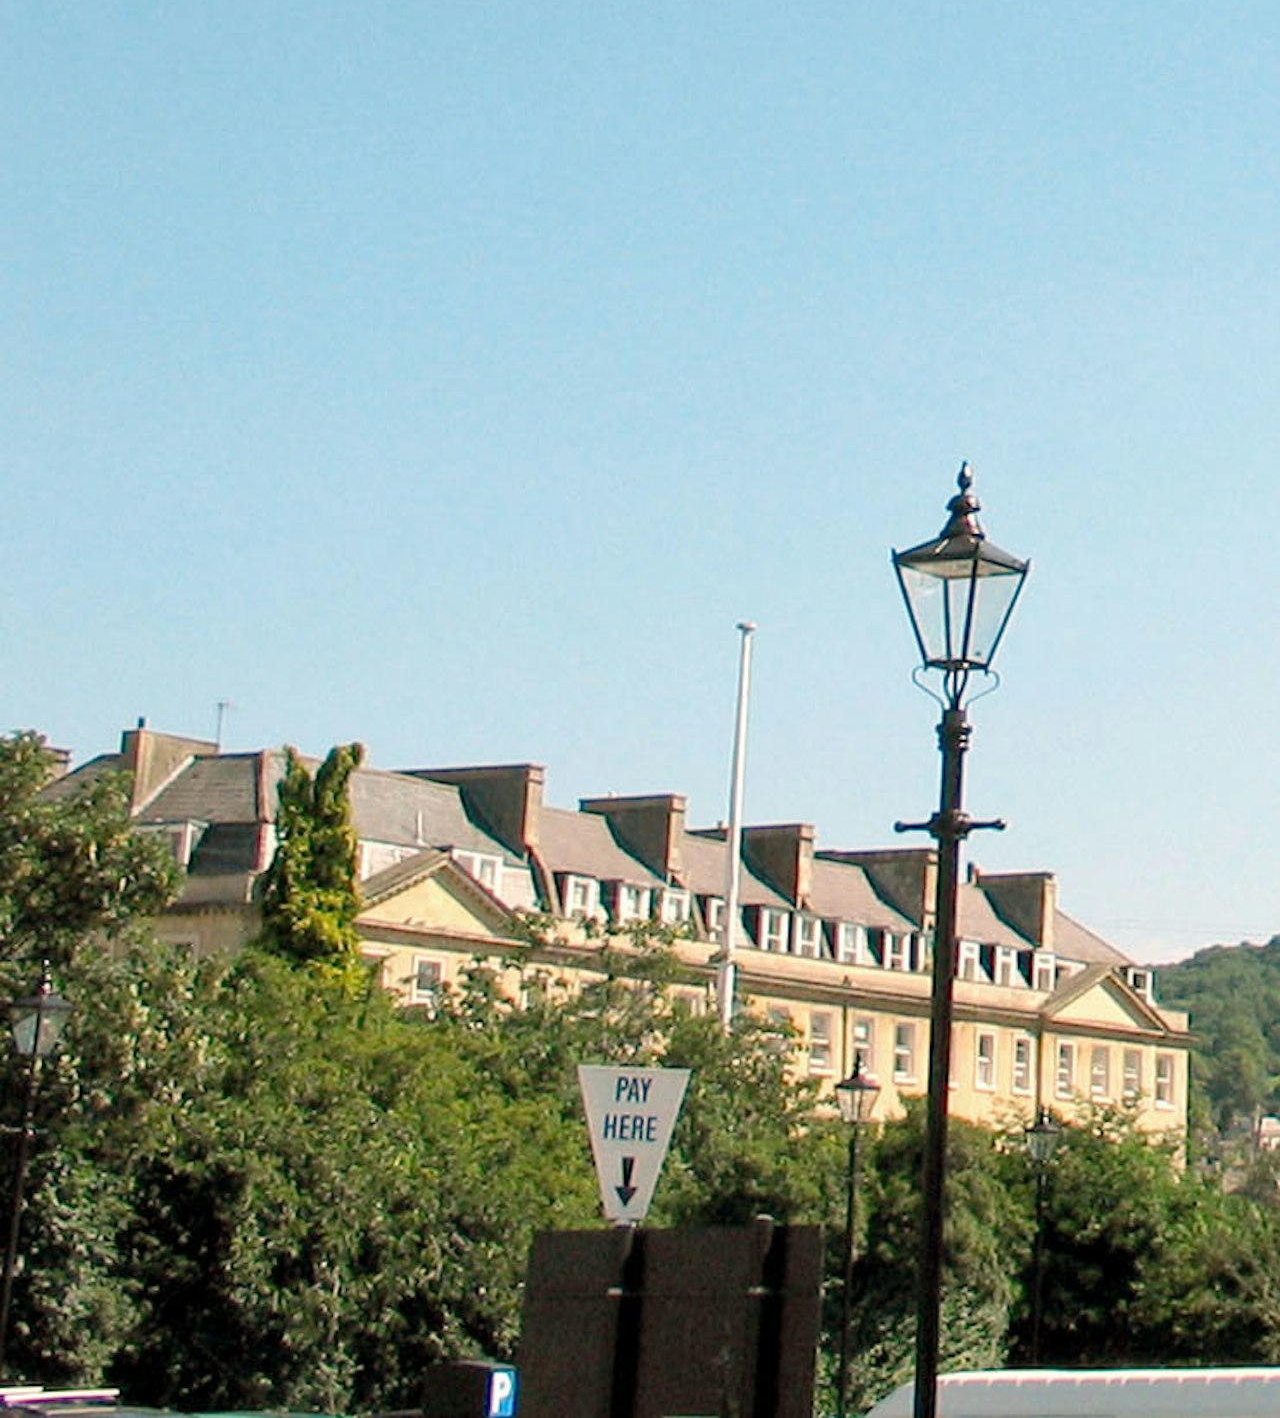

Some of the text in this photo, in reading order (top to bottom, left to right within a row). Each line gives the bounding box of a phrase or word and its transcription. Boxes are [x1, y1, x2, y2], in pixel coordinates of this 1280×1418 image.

[615, 1077, 653, 1103] PAY
[603, 1114, 658, 1142] HERE
[490, 1371, 512, 1414] P
